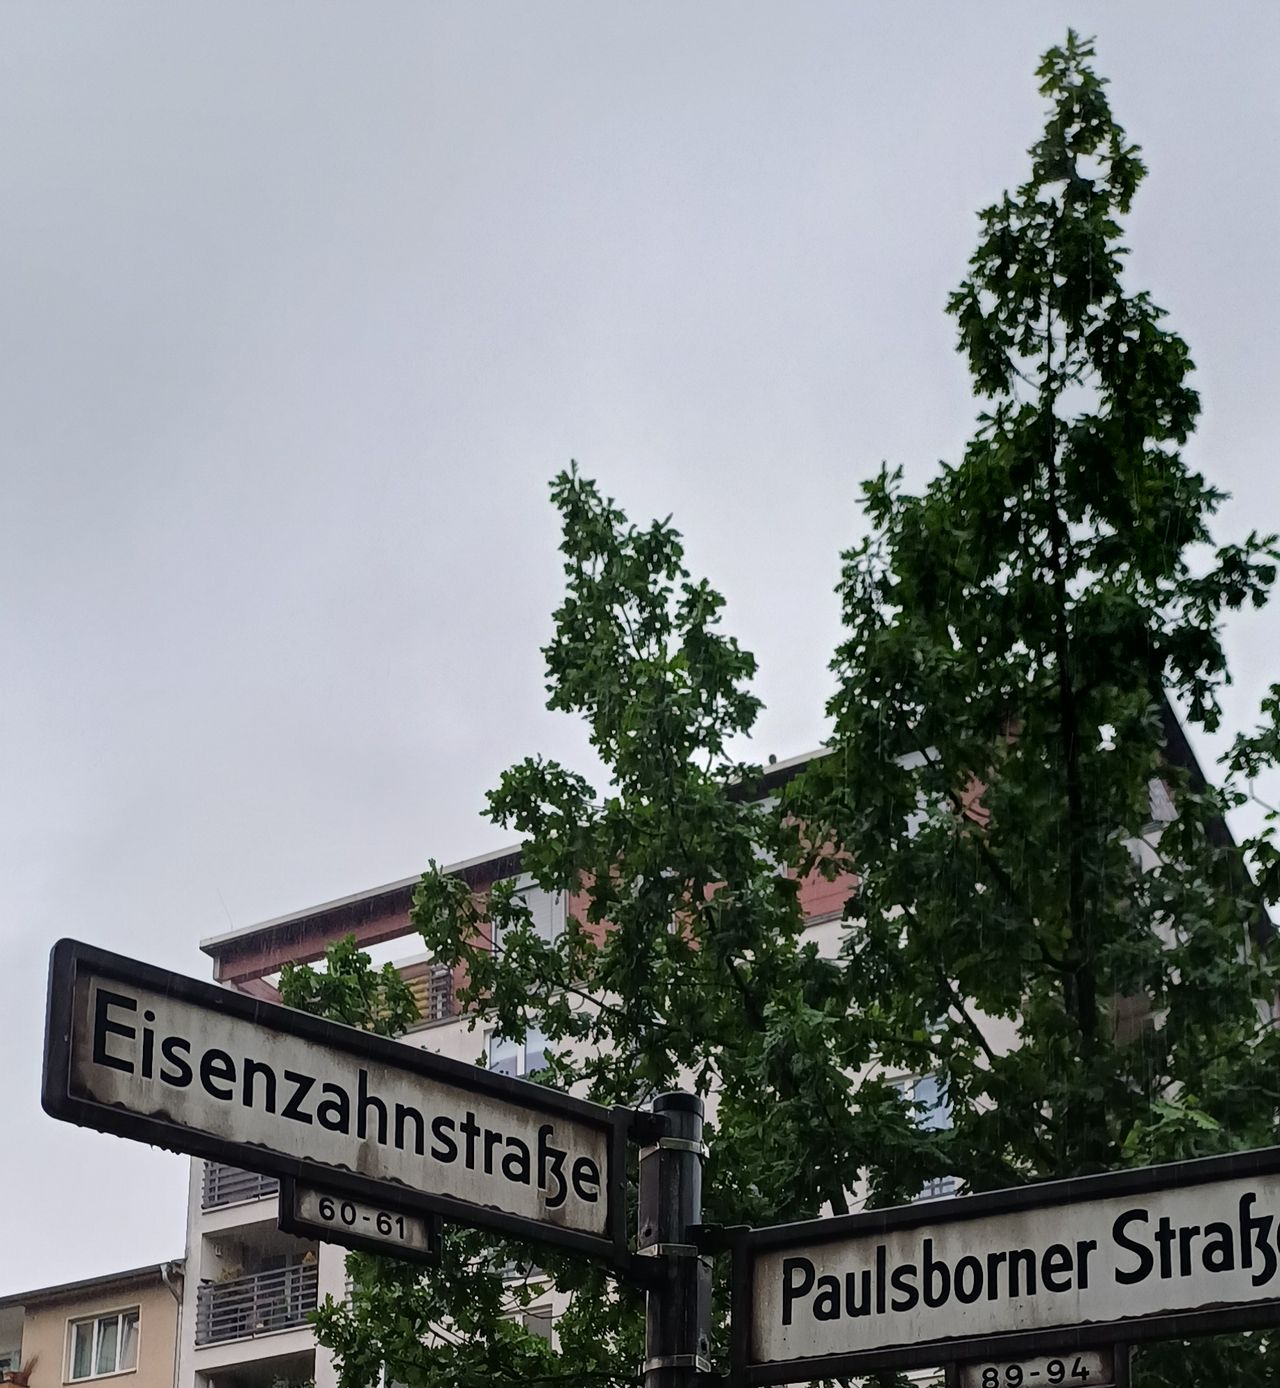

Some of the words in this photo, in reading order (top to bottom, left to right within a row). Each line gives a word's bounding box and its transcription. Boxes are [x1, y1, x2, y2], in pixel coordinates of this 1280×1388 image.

[92, 988, 601, 1208] Eisenzahnstraße
[317, 1196, 406, 1241] 60-61
[781, 1238, 1098, 1326] Paulsborner
[1111, 1191, 1280, 1287] Straß
